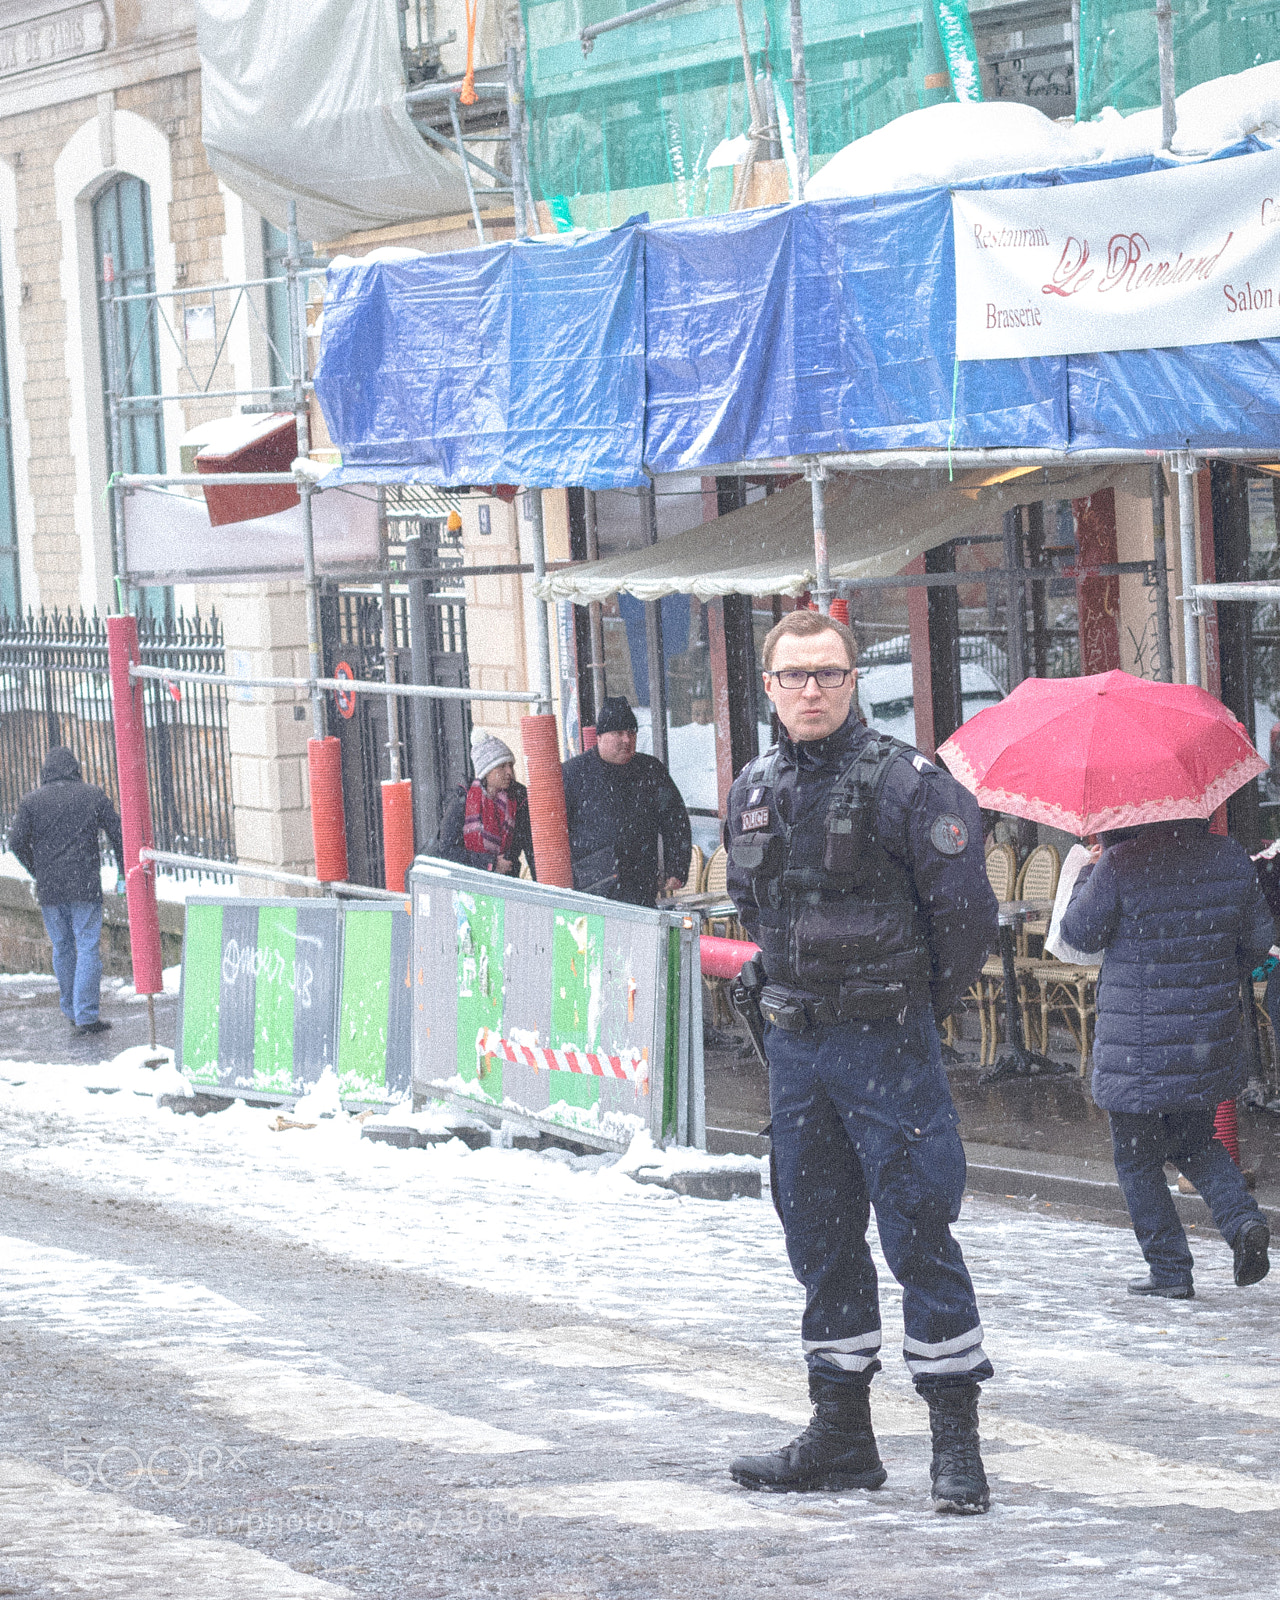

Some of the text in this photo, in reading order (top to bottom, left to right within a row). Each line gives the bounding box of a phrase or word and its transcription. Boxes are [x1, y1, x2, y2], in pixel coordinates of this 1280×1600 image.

[49, 19, 85, 57] PARIS
[974, 224, 1049, 249] Restaurant
[1041, 231, 1234, 298] Le Ronsard
[1223, 281, 1273, 313] Salon
[986, 299, 1042, 329] Brasserie
